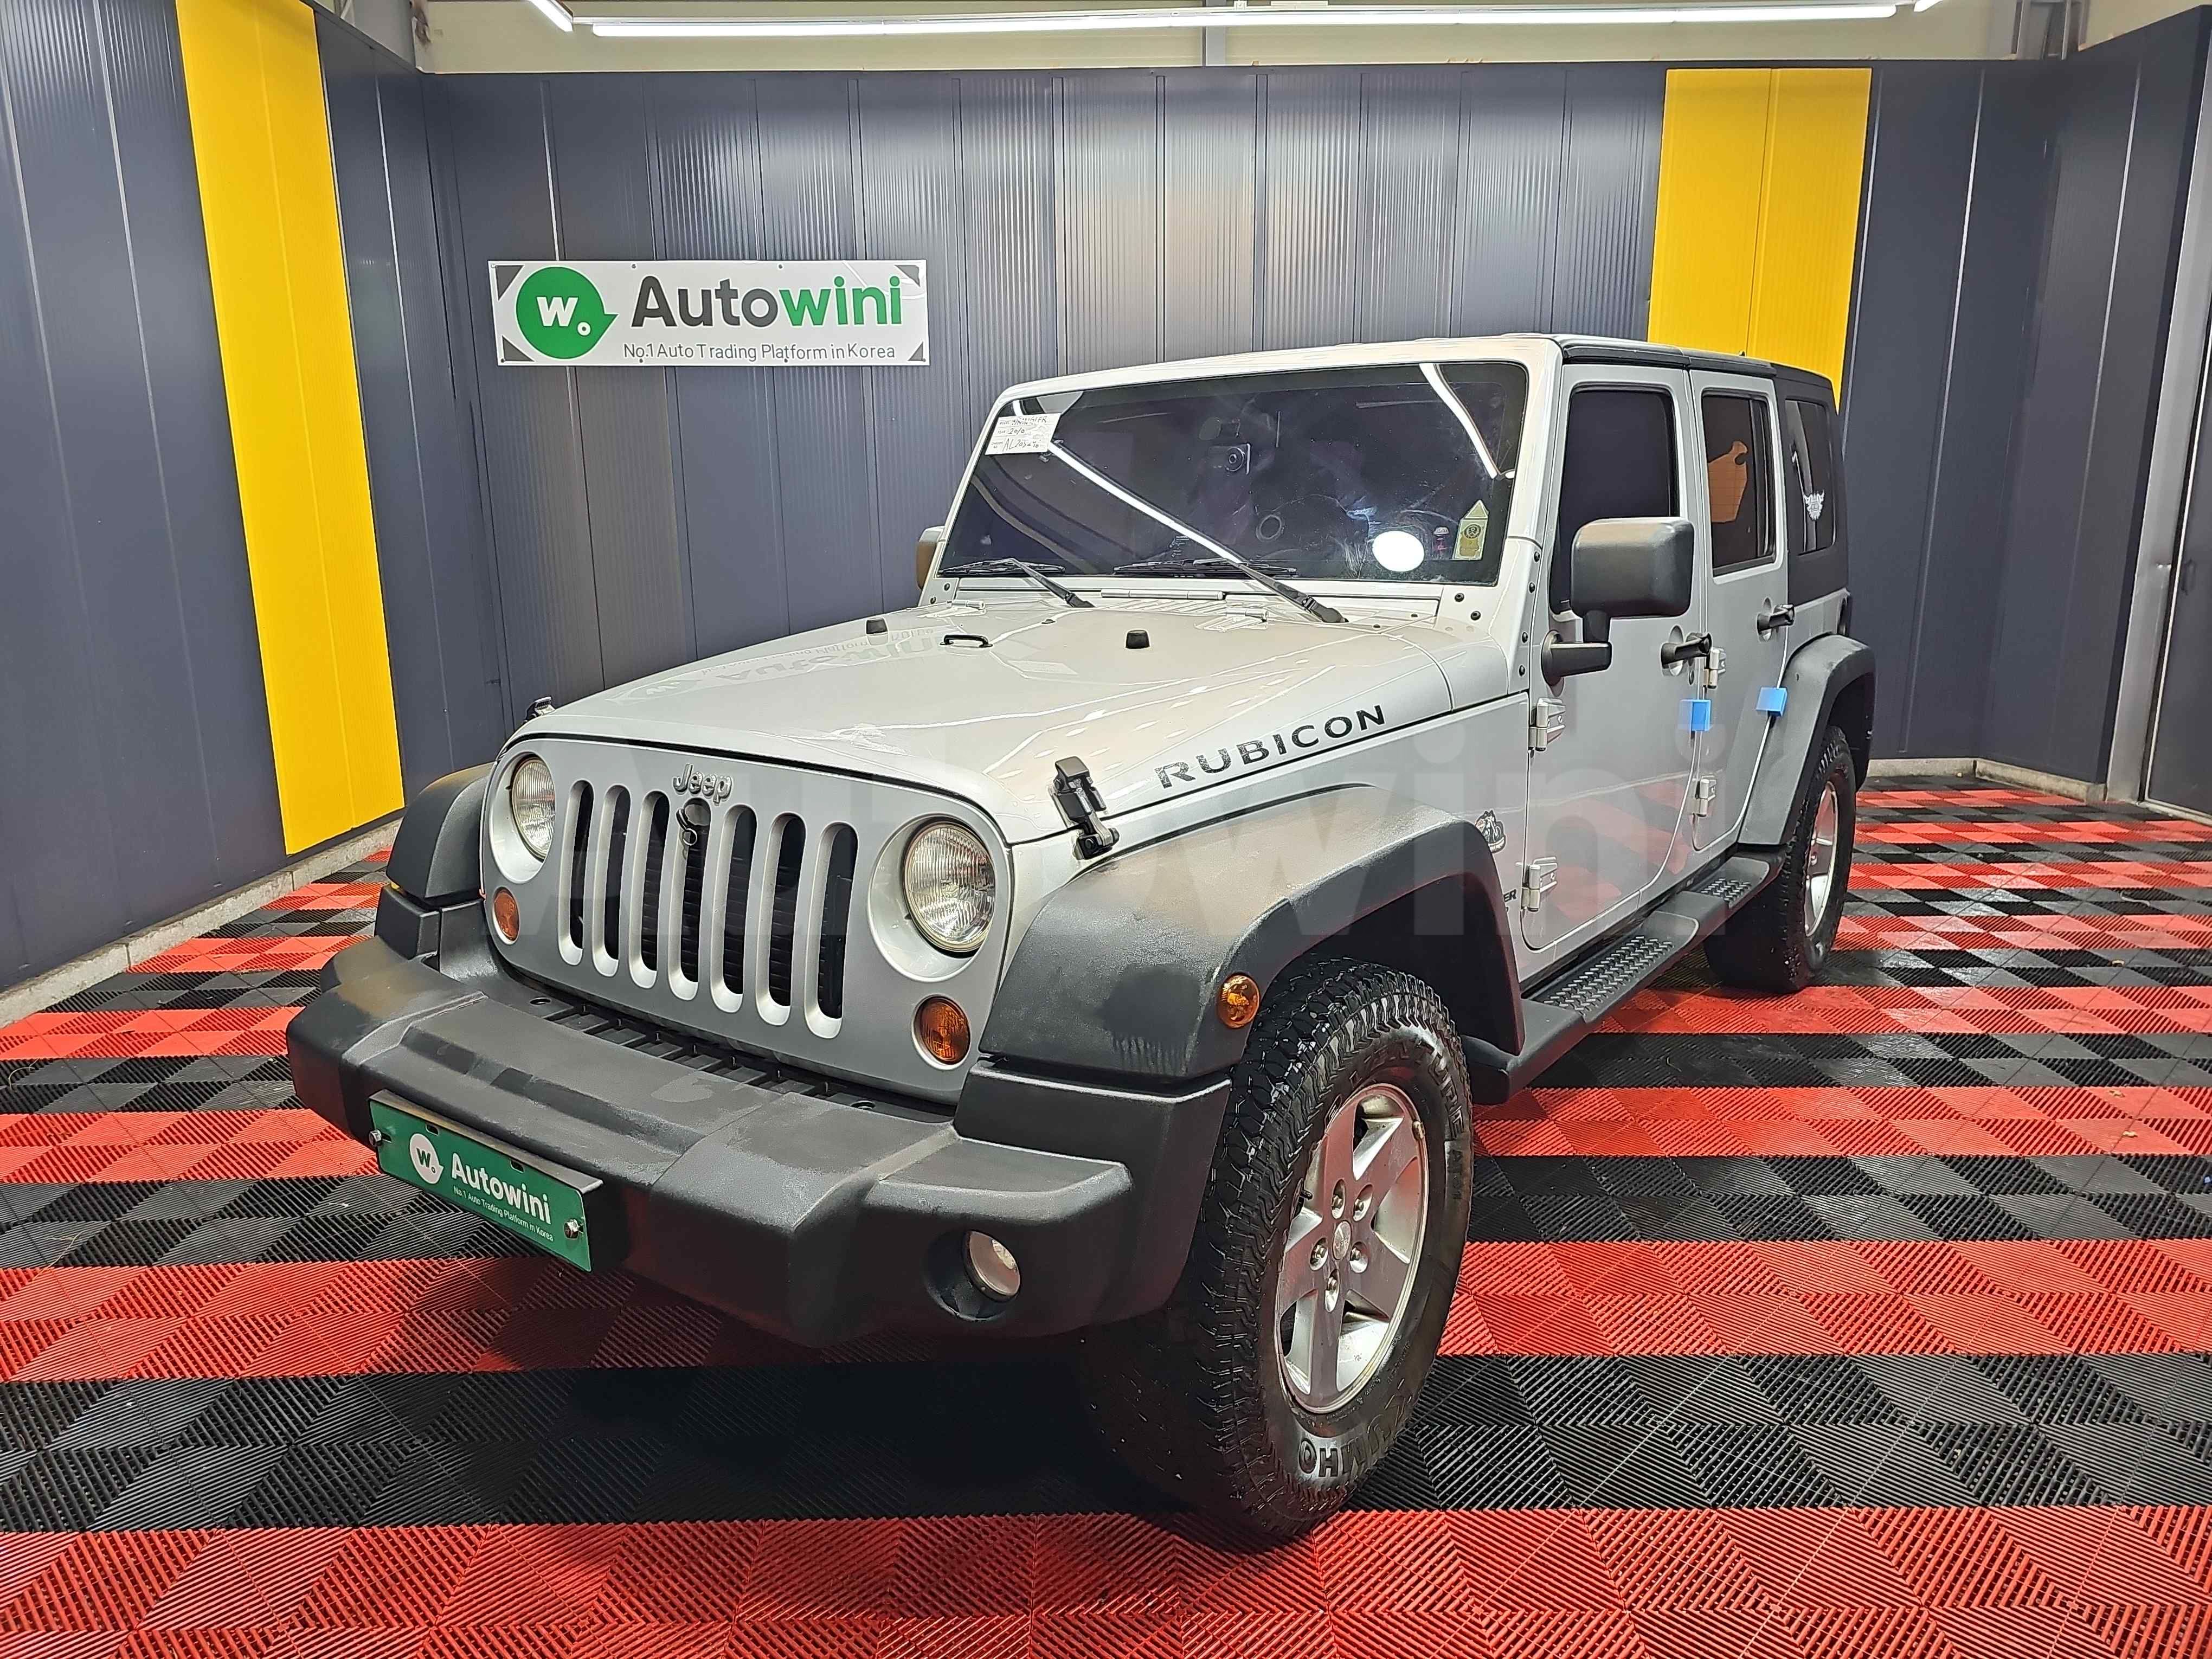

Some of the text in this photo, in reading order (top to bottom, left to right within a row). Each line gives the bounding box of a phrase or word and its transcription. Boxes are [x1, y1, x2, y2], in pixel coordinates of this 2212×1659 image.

[632, 275, 902, 327] Autowini
[624, 343, 653, 358] No.1
[657, 343, 693, 358] Auto
[761, 344, 827, 359] Platform
[831, 344, 845, 359] in
[847, 343, 895, 358] Korea
[1154, 705, 1386, 789] RUBICON
[673, 763, 732, 806] Jeep
[452, 1153, 551, 1225] Autowini
[453, 1185, 554, 1242] No.1 Auto Trading Platform in Korea
